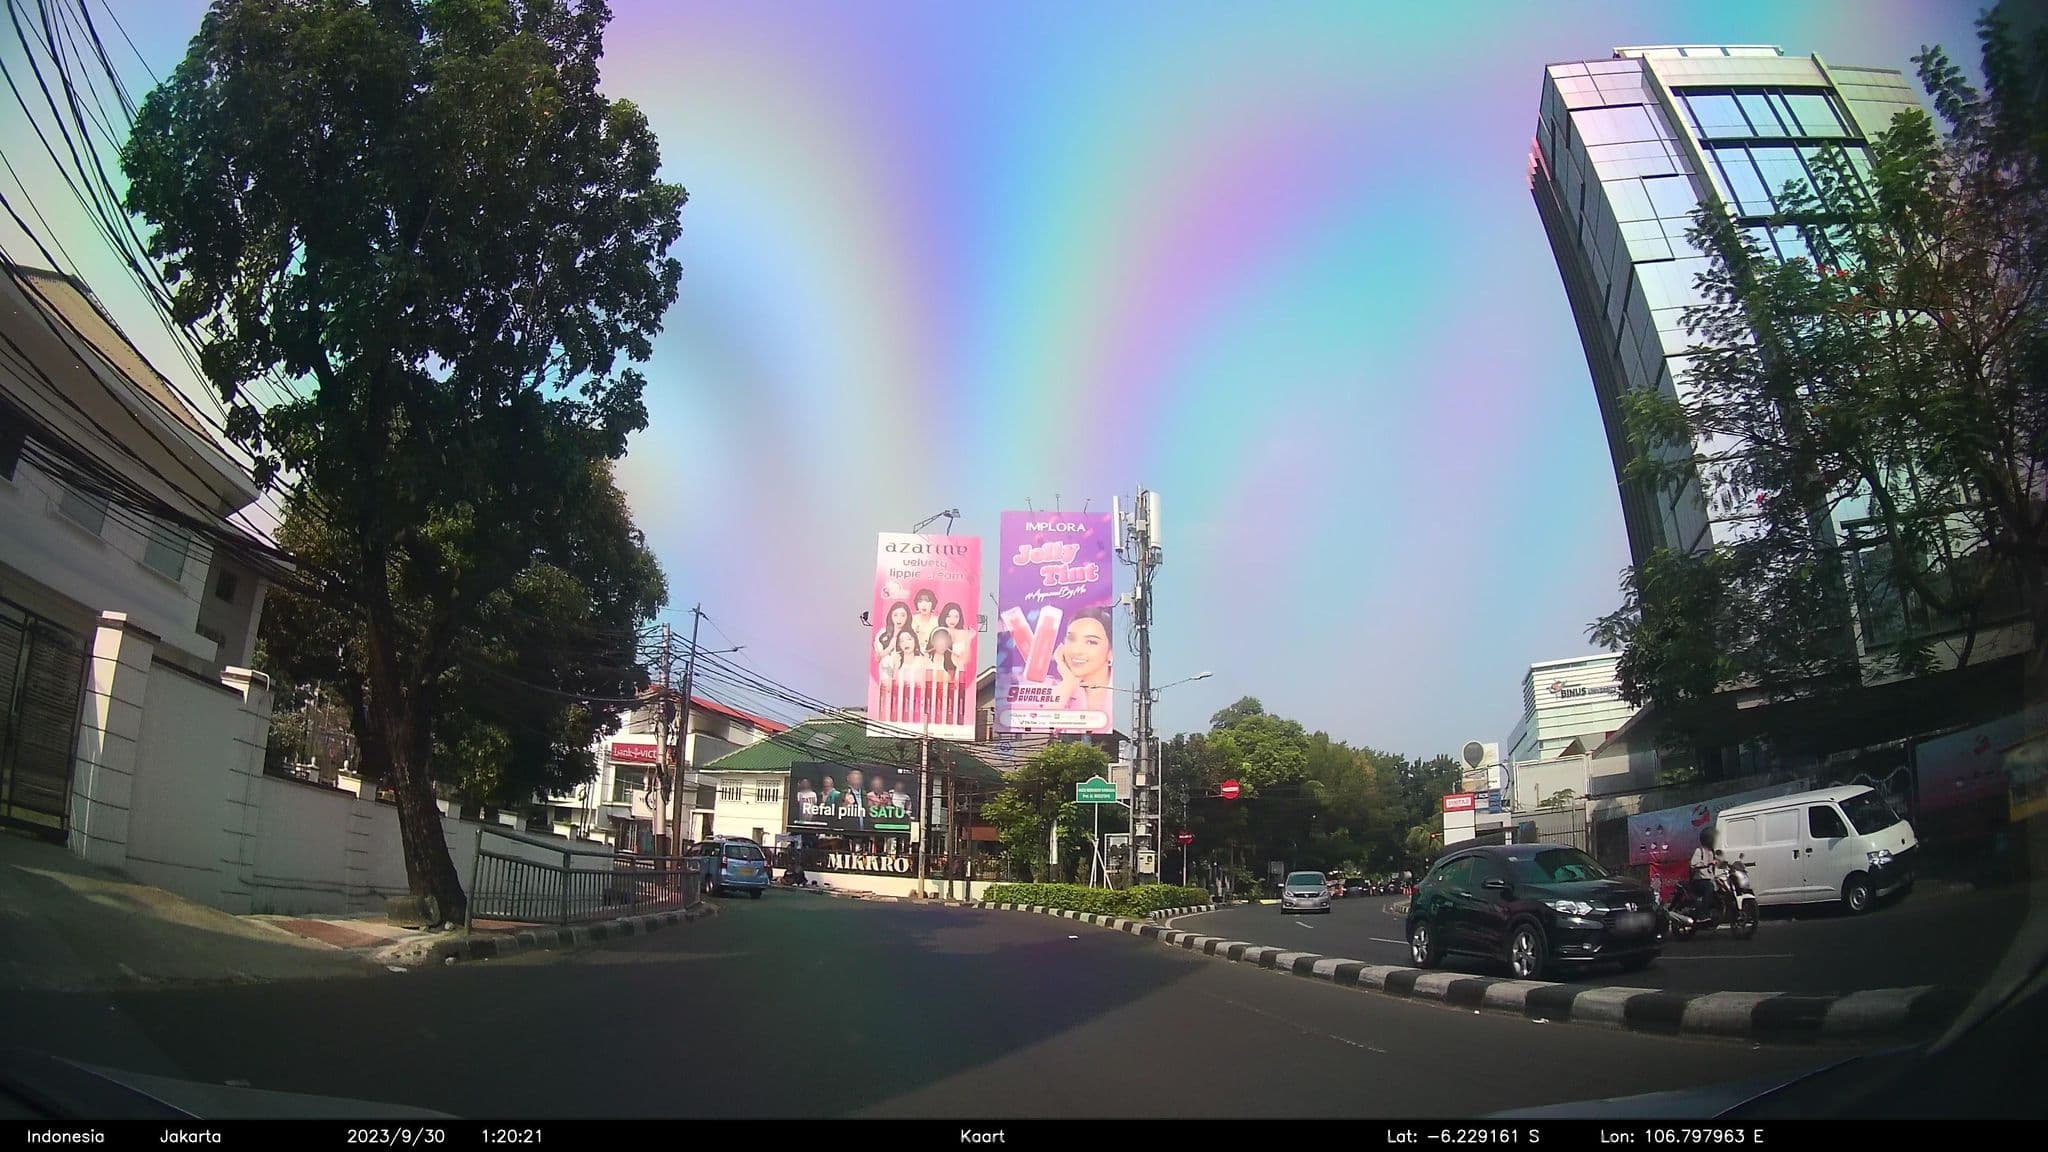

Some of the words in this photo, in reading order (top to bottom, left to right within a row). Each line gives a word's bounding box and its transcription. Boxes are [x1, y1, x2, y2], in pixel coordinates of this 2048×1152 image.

[1025, 521, 1086, 532] IMPLORA
[885, 542, 968, 555] azarine
[1040, 562, 1099, 587] Tint
[1007, 686, 1019, 703] 9
[1019, 687, 1053, 695] SHADES
[1018, 695, 1061, 703] AVAILABLE
[1560, 687, 1587, 699] BINUS
[802, 802, 836, 817] Refal
[838, 803, 866, 820] pilih
[869, 805, 905, 819] SATU
